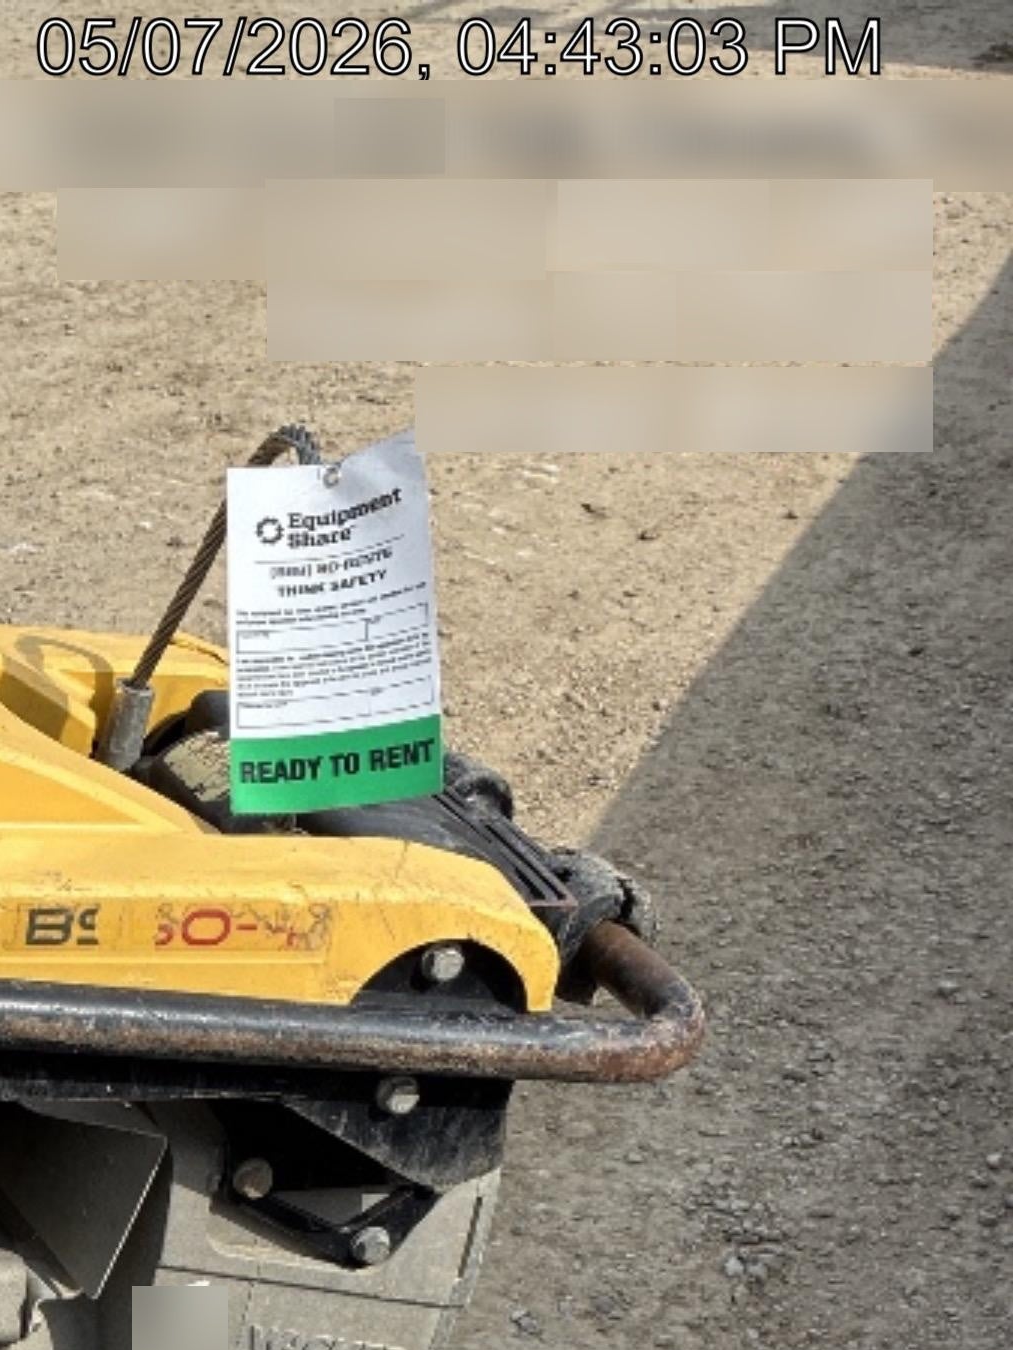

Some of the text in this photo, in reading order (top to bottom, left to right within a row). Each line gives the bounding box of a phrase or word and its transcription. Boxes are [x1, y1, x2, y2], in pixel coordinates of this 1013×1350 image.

[286, 487, 402, 531] Equipment
[286, 527, 352, 550] Share
[277, 581, 325, 598] THINK
[329, 568, 388, 592] SAFETY
[239, 738, 435, 785] READY TO RENT
